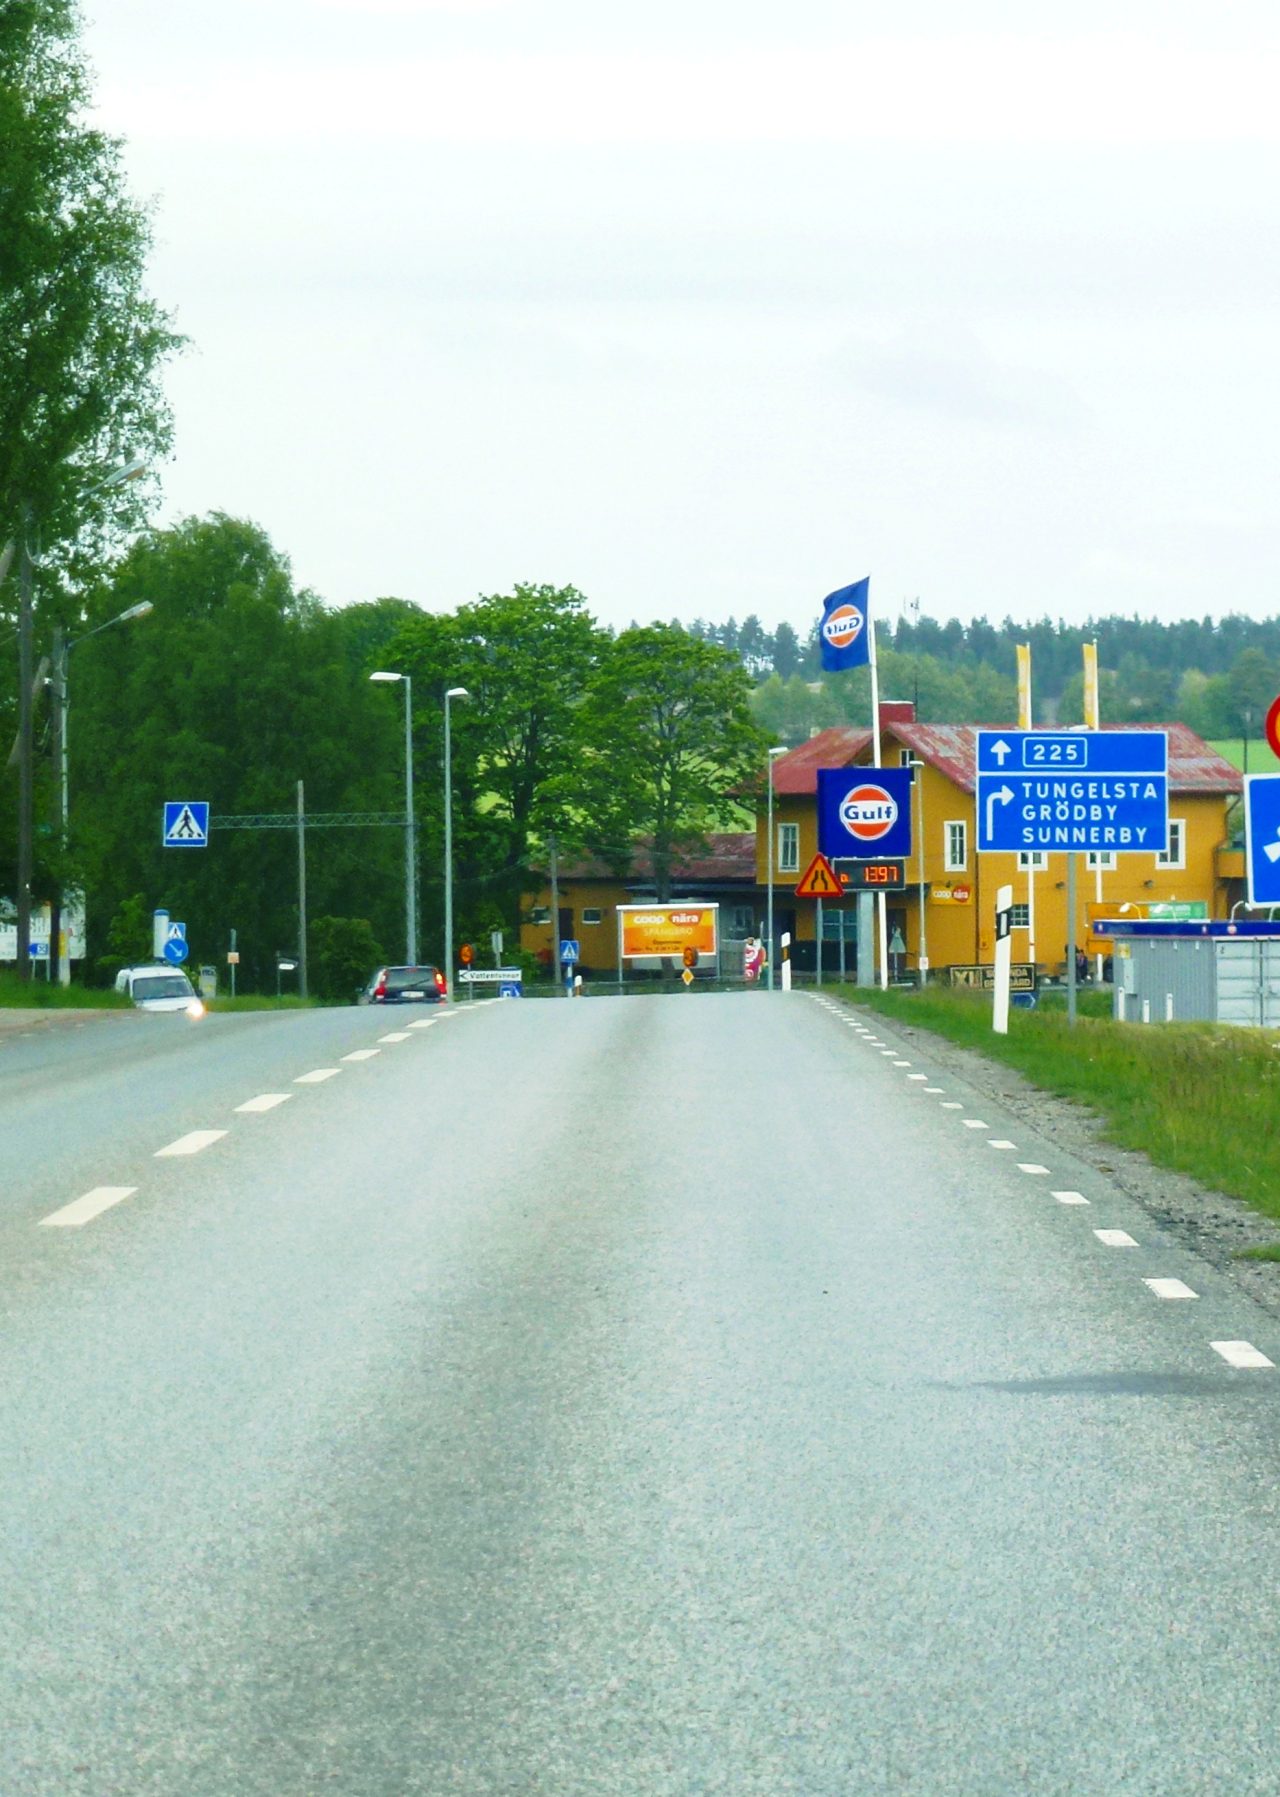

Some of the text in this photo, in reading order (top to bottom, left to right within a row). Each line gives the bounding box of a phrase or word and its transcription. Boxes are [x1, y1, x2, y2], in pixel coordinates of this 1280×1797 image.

[1033, 744, 1078, 761] 225
[1022, 782, 1157, 799] TUNGELSTA
[844, 804, 894, 820] Gulf
[1022, 800, 1118, 821] GRÖDBY
[1023, 827, 1148, 844] SUNNERBY
[633, 912, 699, 925] coop nära
